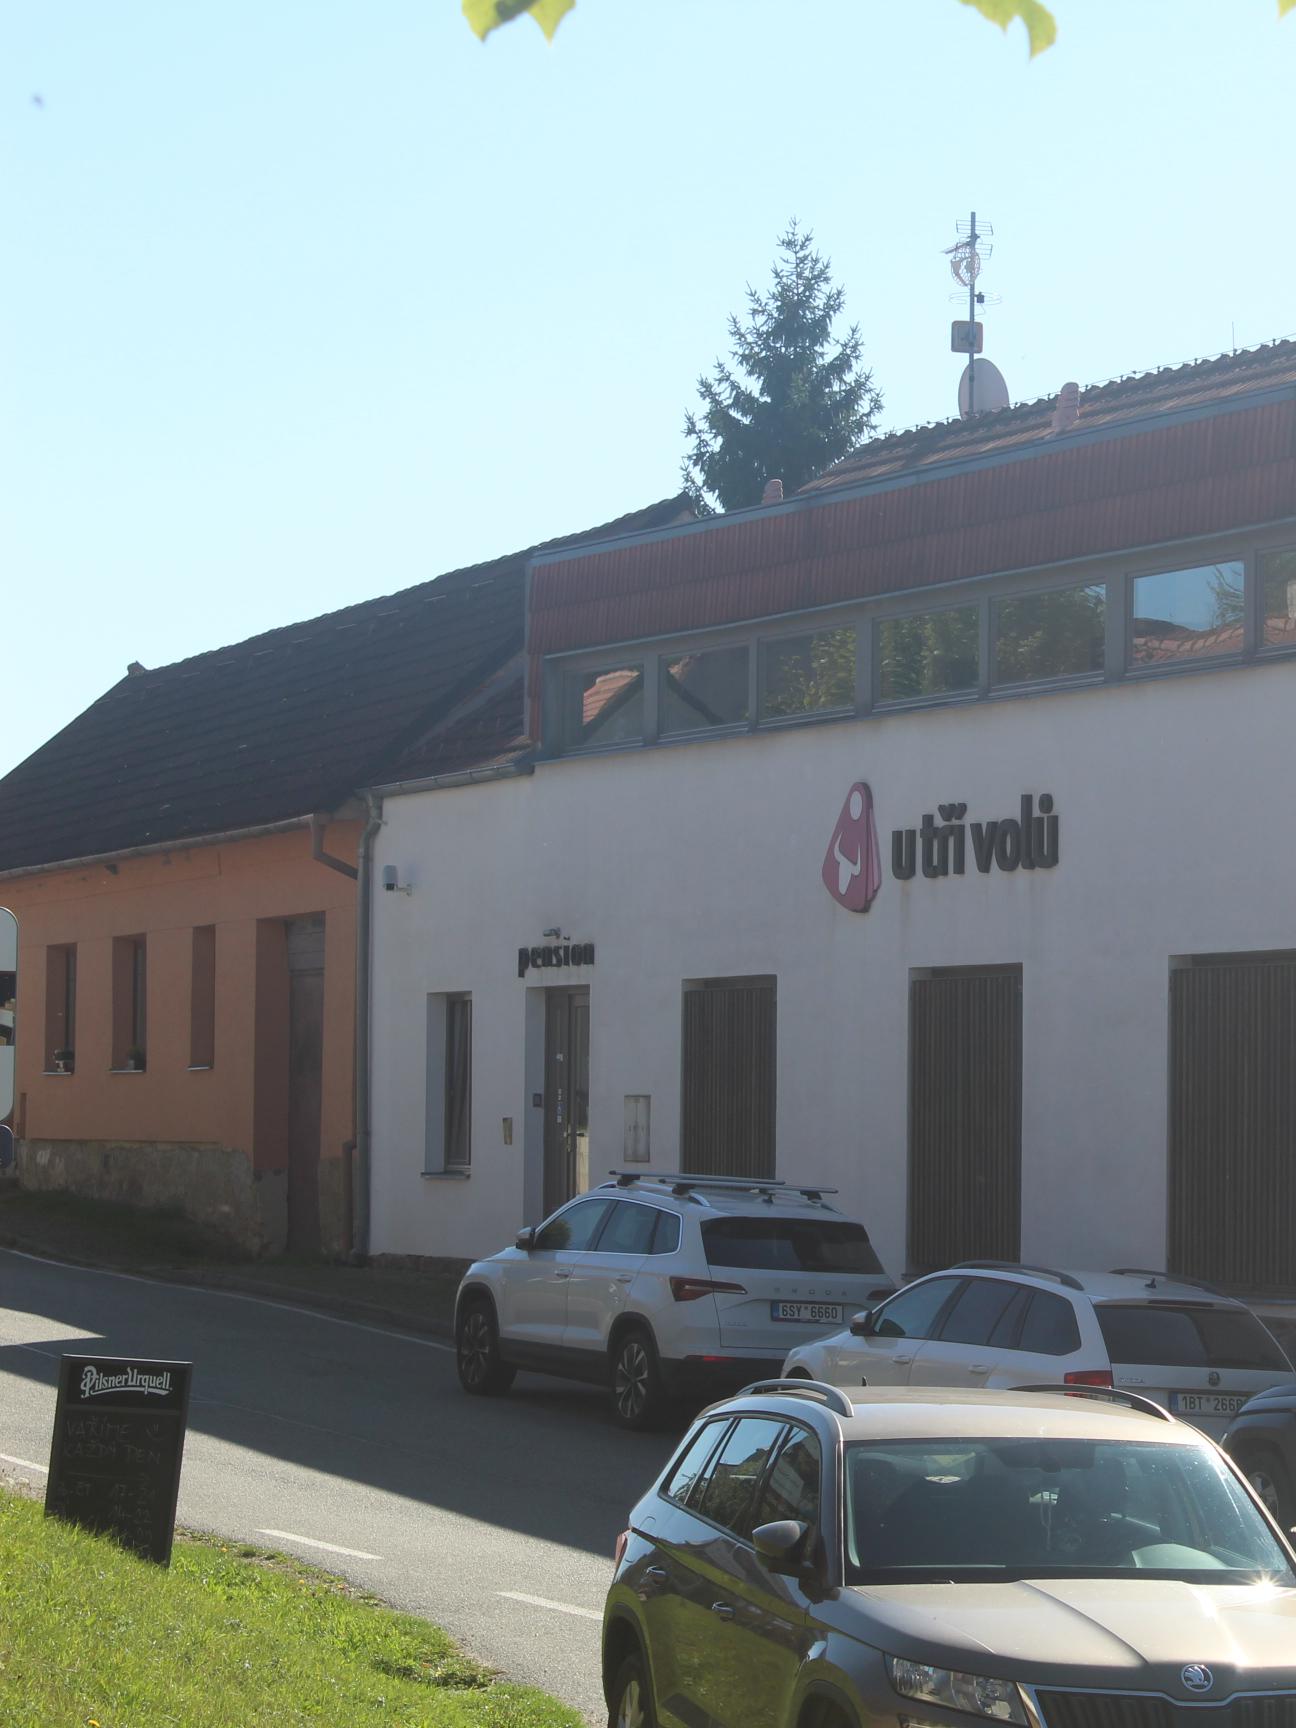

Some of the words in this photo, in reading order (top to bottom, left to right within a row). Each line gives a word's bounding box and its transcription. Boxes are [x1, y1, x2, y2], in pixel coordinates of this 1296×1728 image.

[518, 936, 596, 978] pension
[781, 1302, 803, 1318] 6SY
[810, 1305, 838, 1320] 6660
[80, 1365, 129, 1398] Pilsner
[127, 1367, 171, 1395] Urquell
[1182, 1395, 1204, 1411] 1BT
